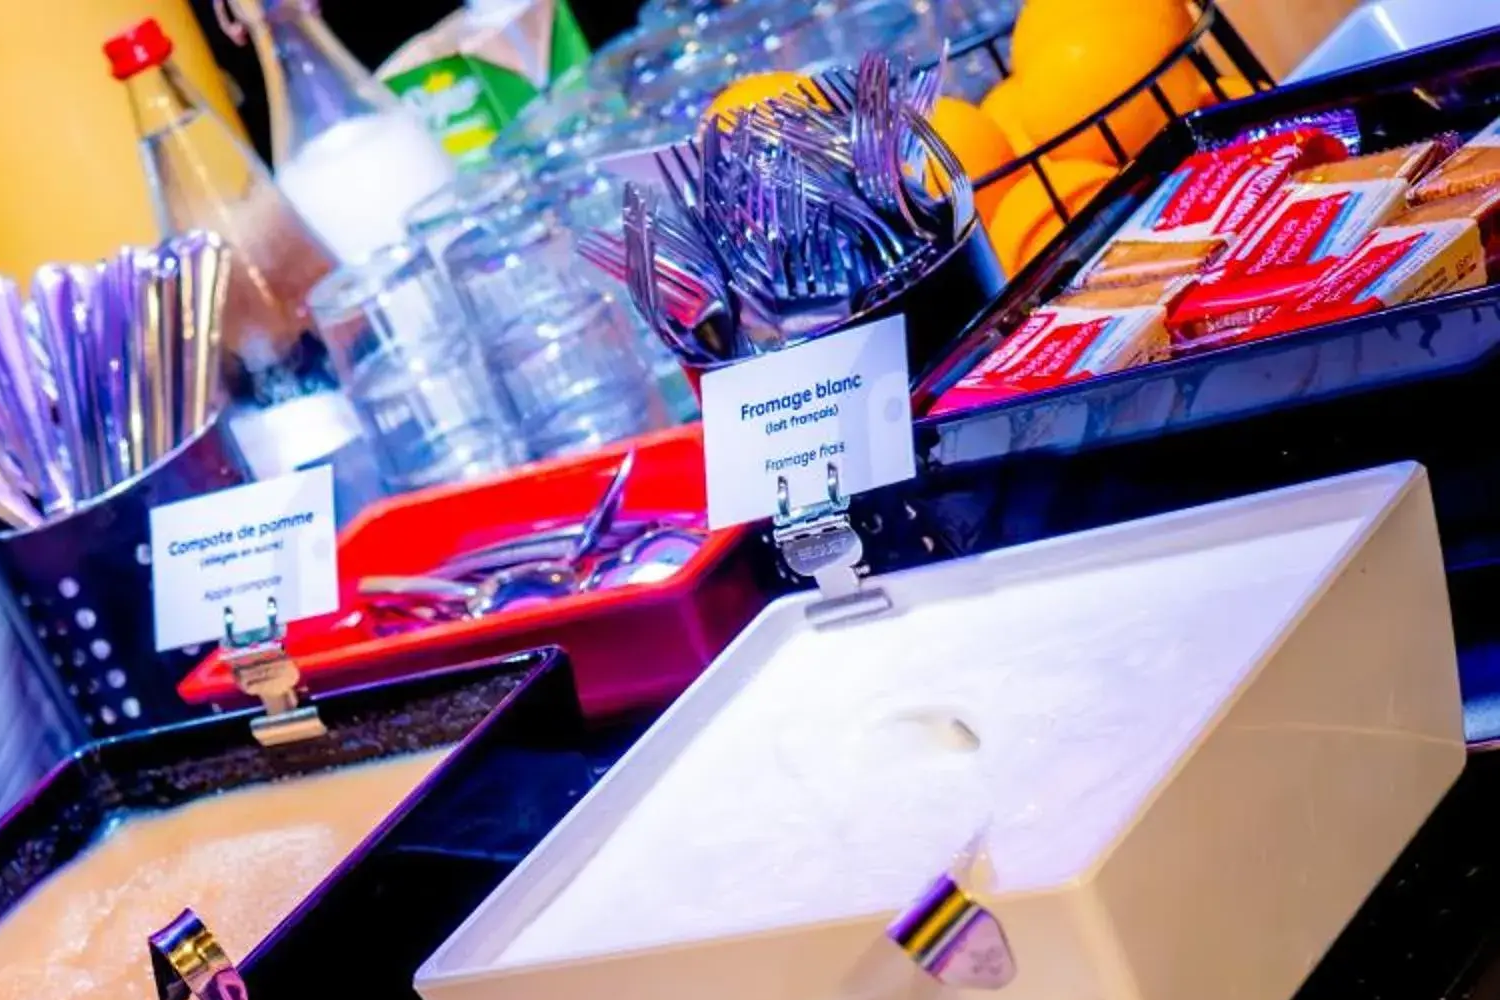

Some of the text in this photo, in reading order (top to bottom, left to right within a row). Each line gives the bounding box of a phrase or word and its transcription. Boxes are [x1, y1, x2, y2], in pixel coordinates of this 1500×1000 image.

[741, 374, 862, 421] Fromage blanc
[765, 448, 816, 472] Fromage
[168, 512, 314, 556] Compote de pomme
